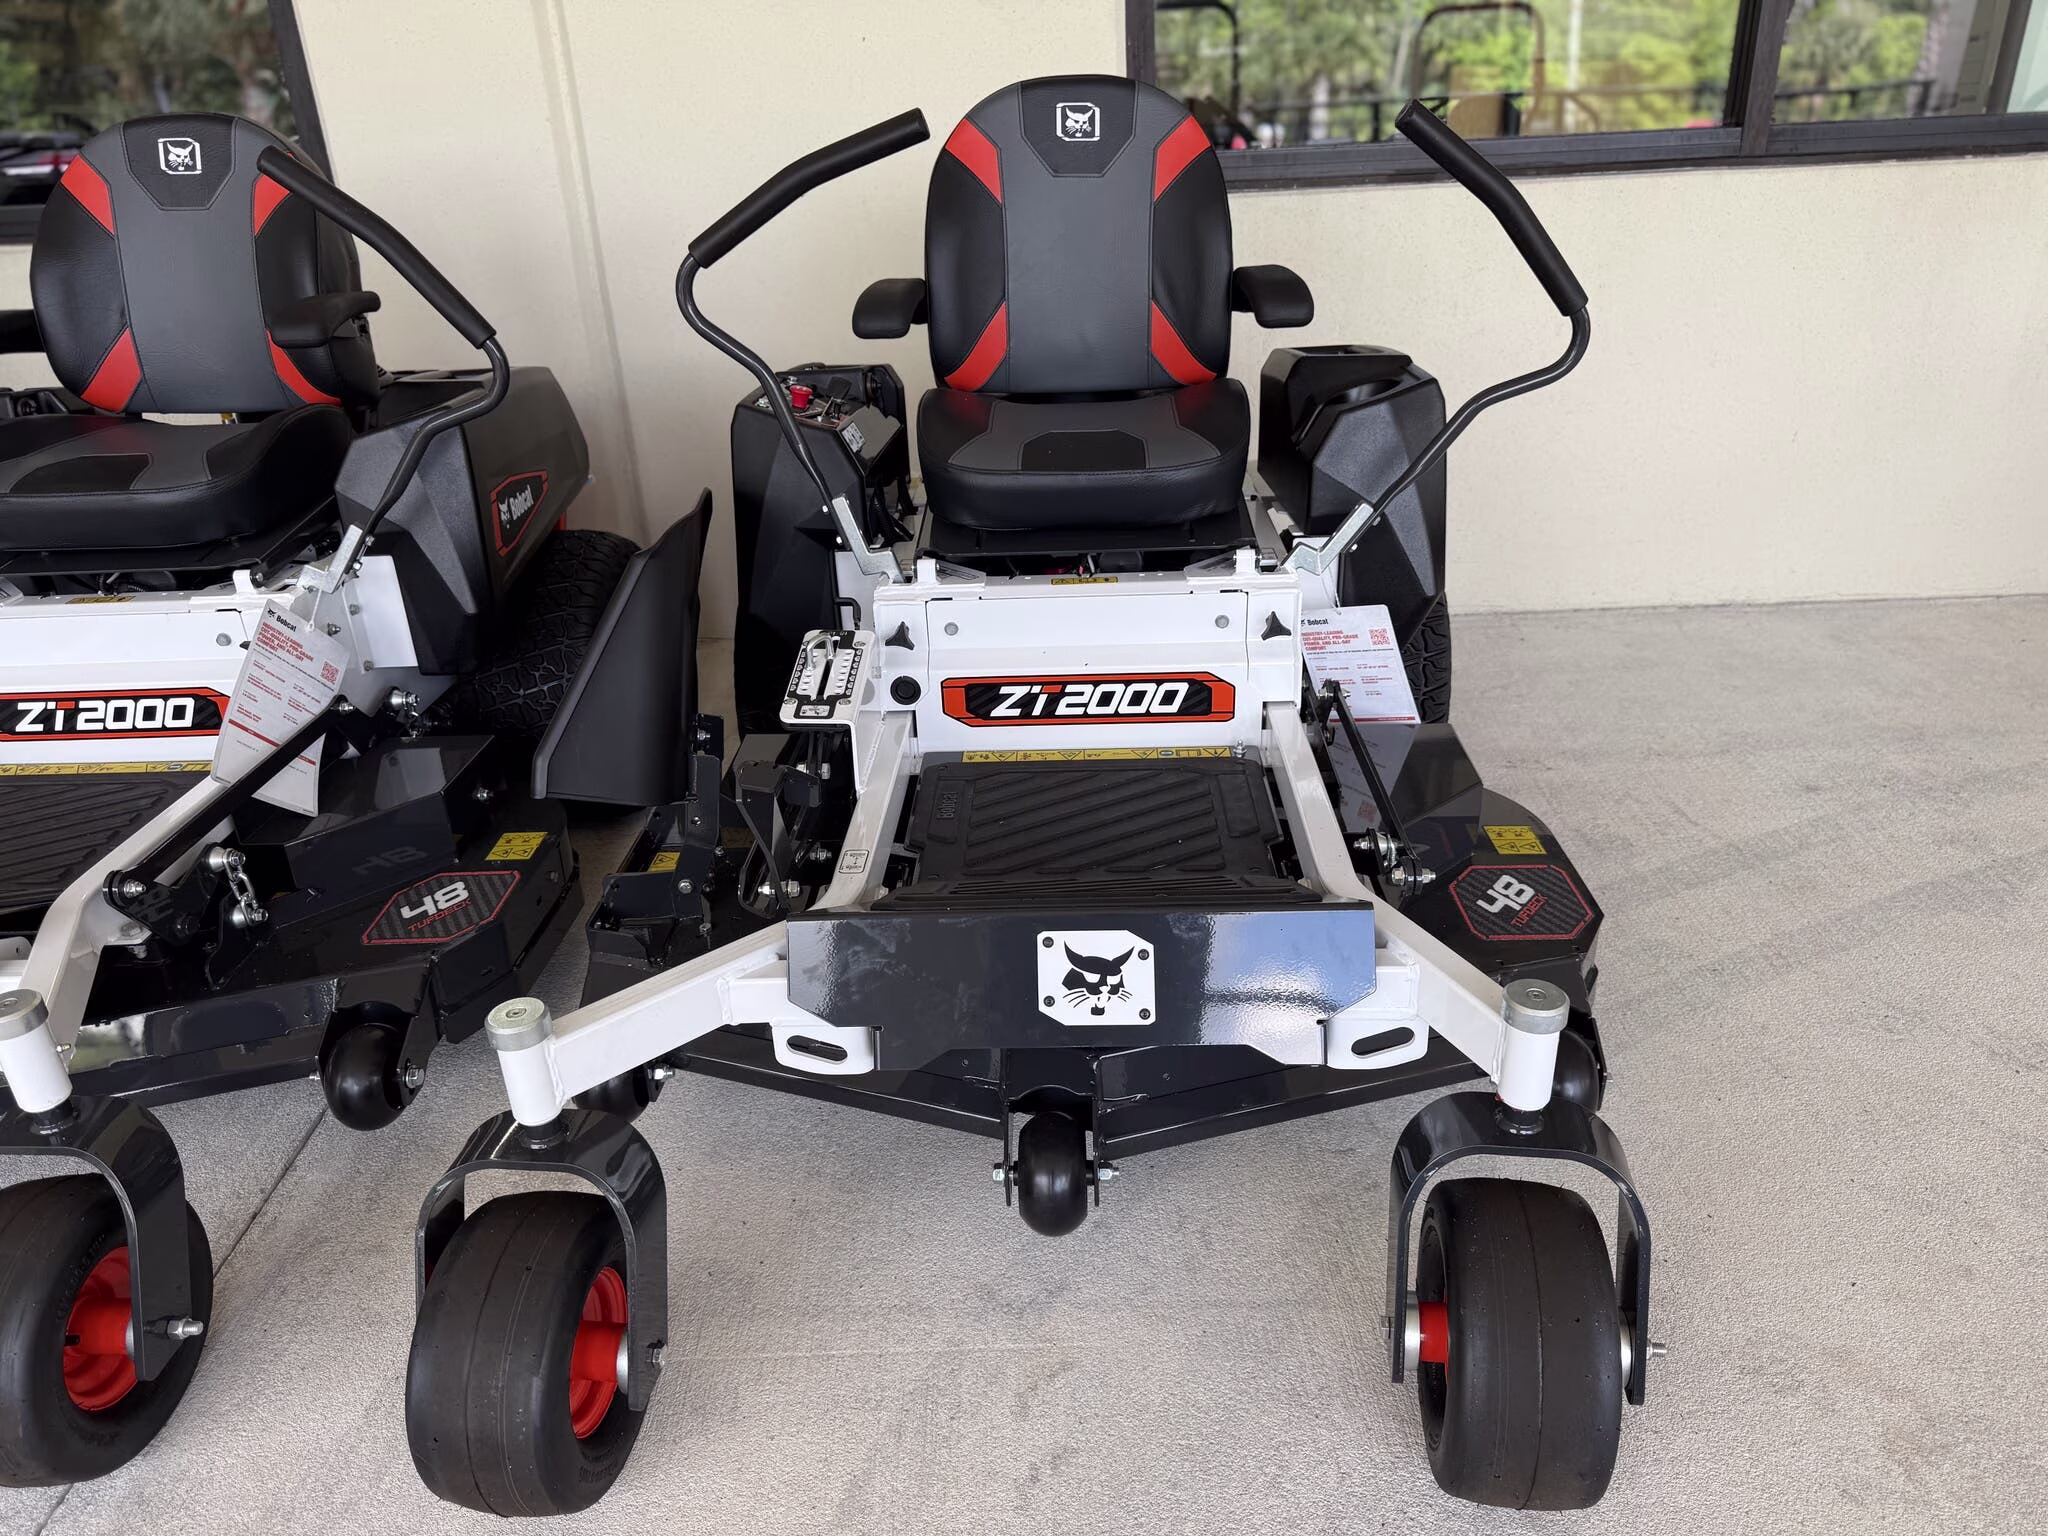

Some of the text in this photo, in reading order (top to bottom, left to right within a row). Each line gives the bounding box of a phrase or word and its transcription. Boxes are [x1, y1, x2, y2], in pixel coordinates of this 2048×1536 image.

[509, 484, 534, 520] Bobcat
[276, 615, 297, 632] Bobcat
[15, 697, 195, 732] ZT2000
[990, 682, 1190, 717] ZT2000
[400, 881, 469, 919] 48
[1476, 874, 1536, 913] 48
[1510, 892, 1548, 927] TUFDECK
[408, 899, 472, 932] TUFDECK
